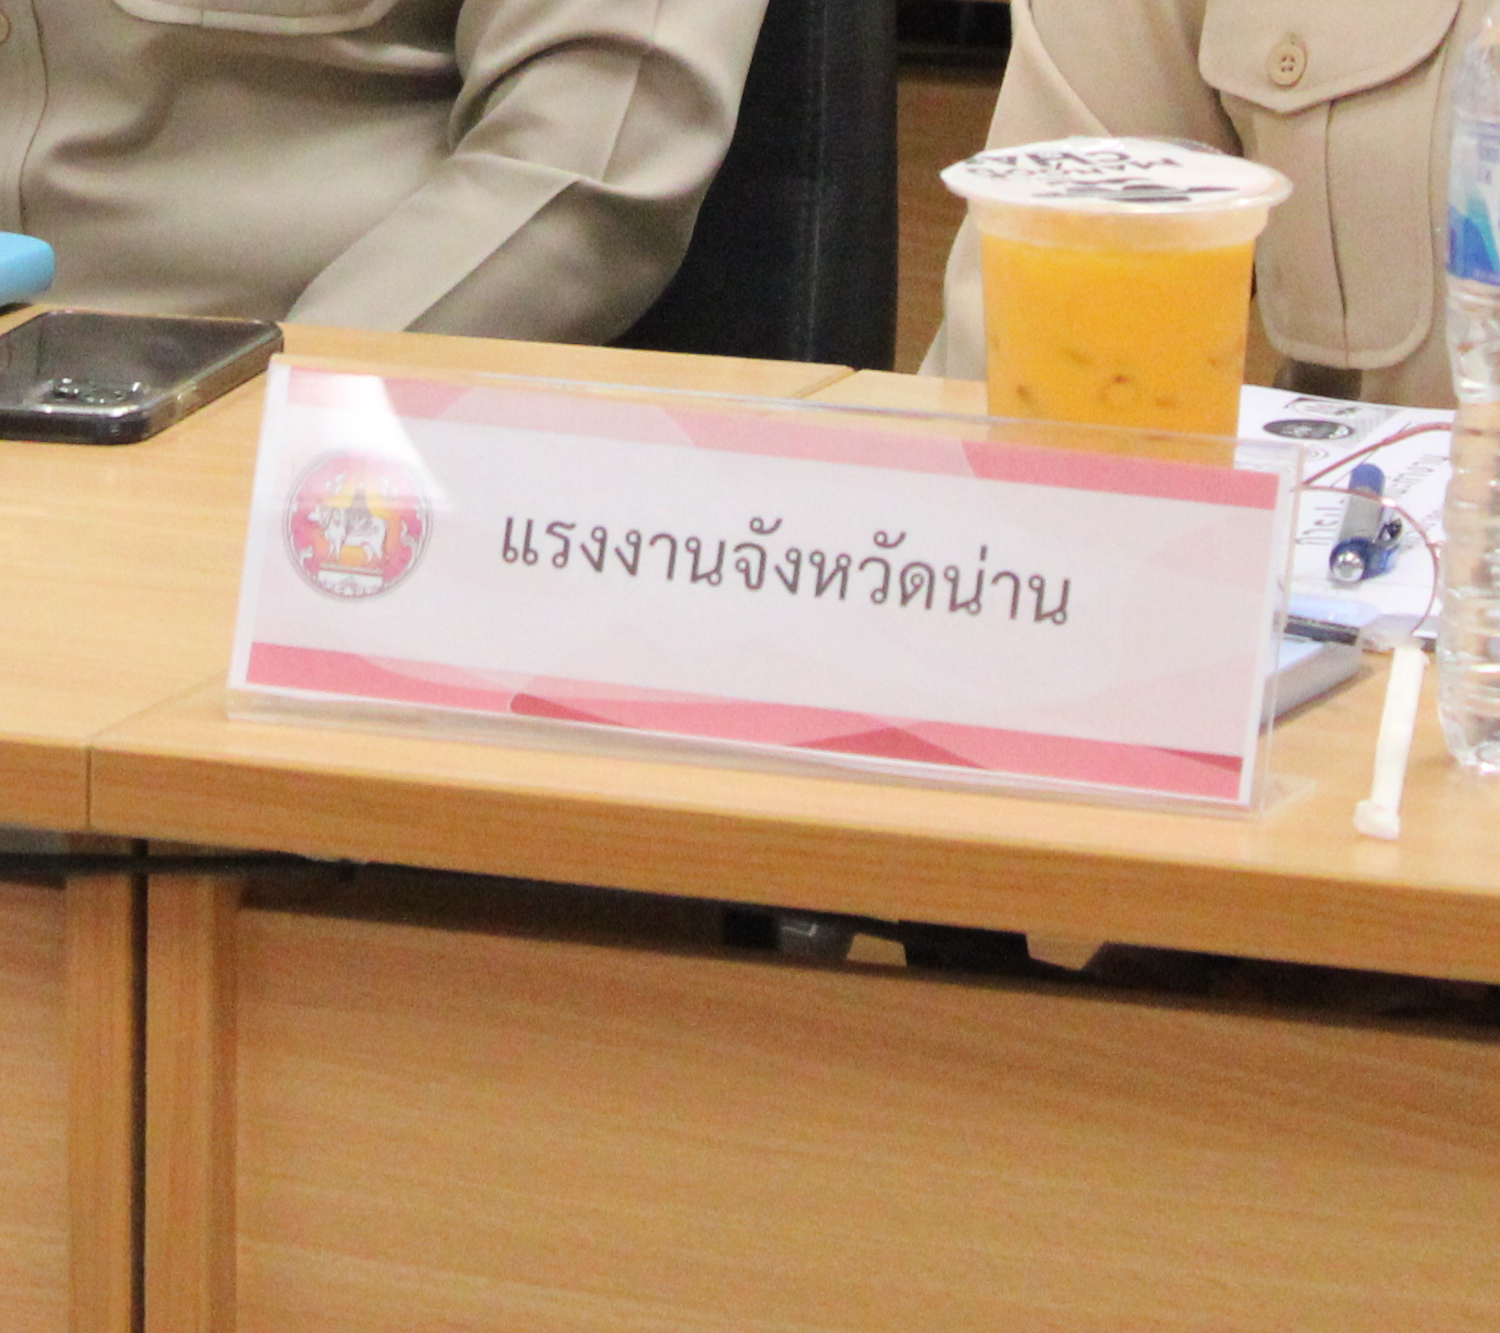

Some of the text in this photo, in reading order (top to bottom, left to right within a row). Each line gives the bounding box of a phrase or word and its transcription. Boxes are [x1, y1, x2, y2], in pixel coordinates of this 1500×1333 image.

[500, 514, 1073, 628] แรงงานจังหวัดน่าน
